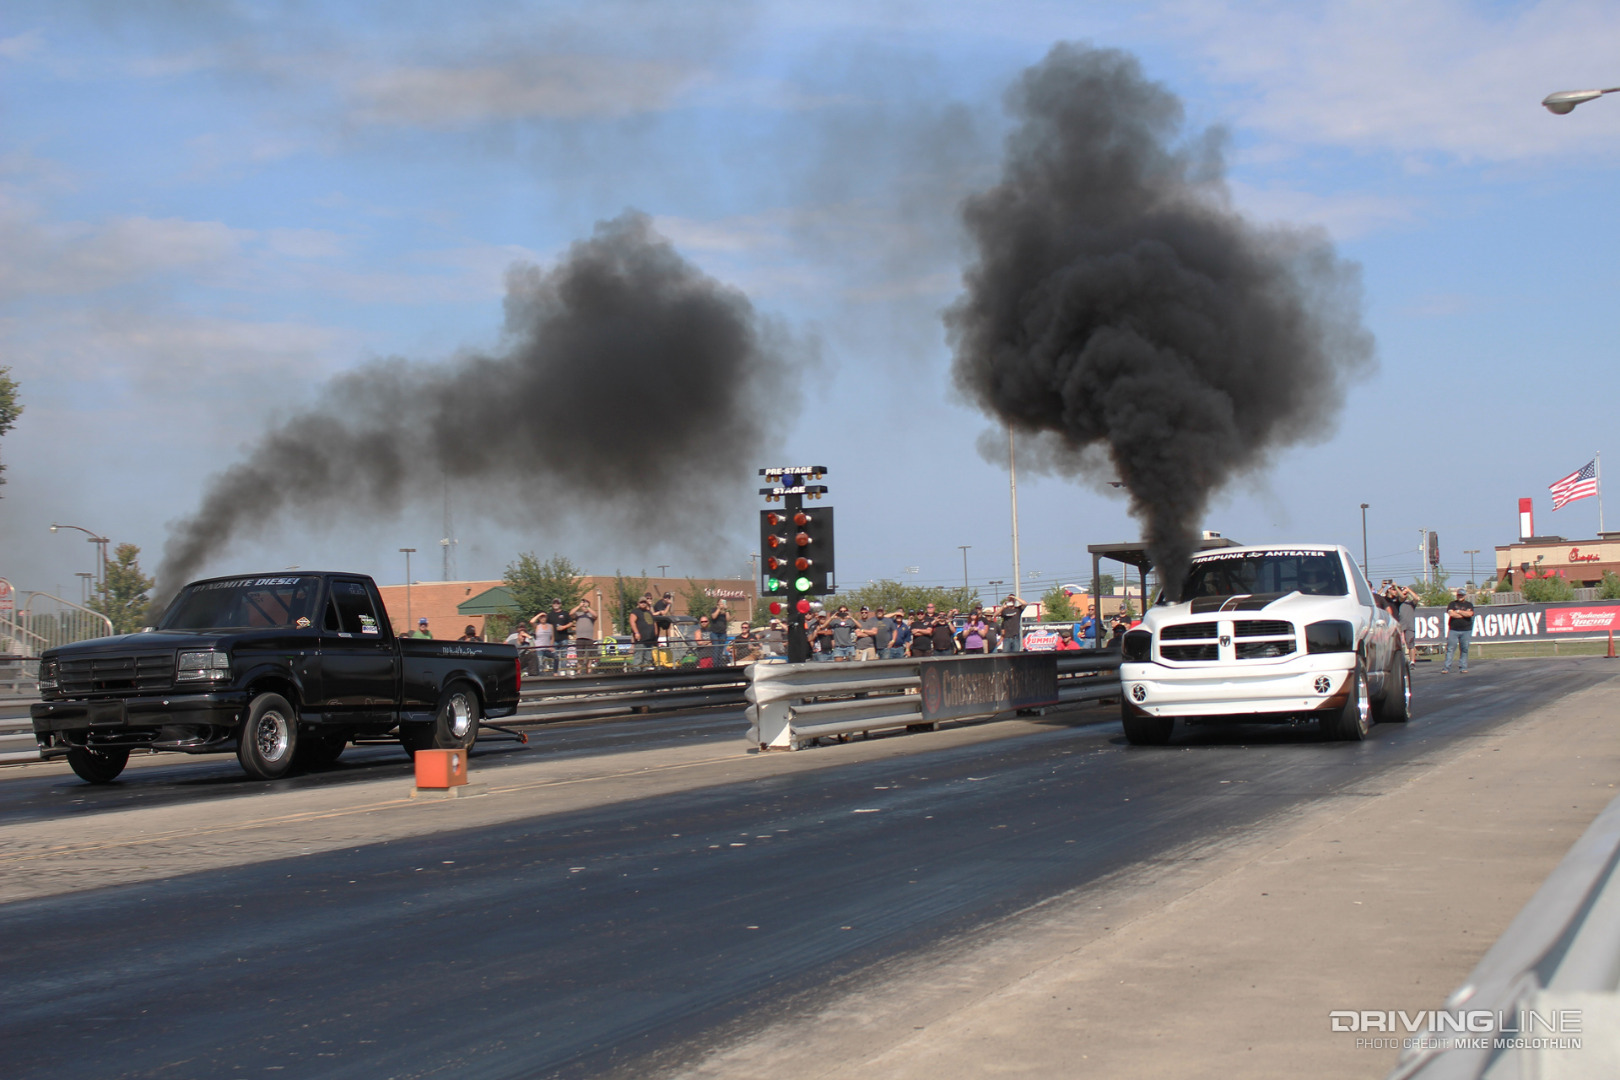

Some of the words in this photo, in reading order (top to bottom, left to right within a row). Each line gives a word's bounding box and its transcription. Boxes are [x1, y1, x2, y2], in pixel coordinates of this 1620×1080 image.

[765, 466, 813, 475] PRE-STAGE
[772, 486, 806, 495] STAGE
[1192, 553, 1245, 563] FIREPUNK
[192, 579, 254, 593] DYNOMITE
[1444, 611, 1542, 638] AGWAY
[1026, 633, 1056, 645] SUMMIT
